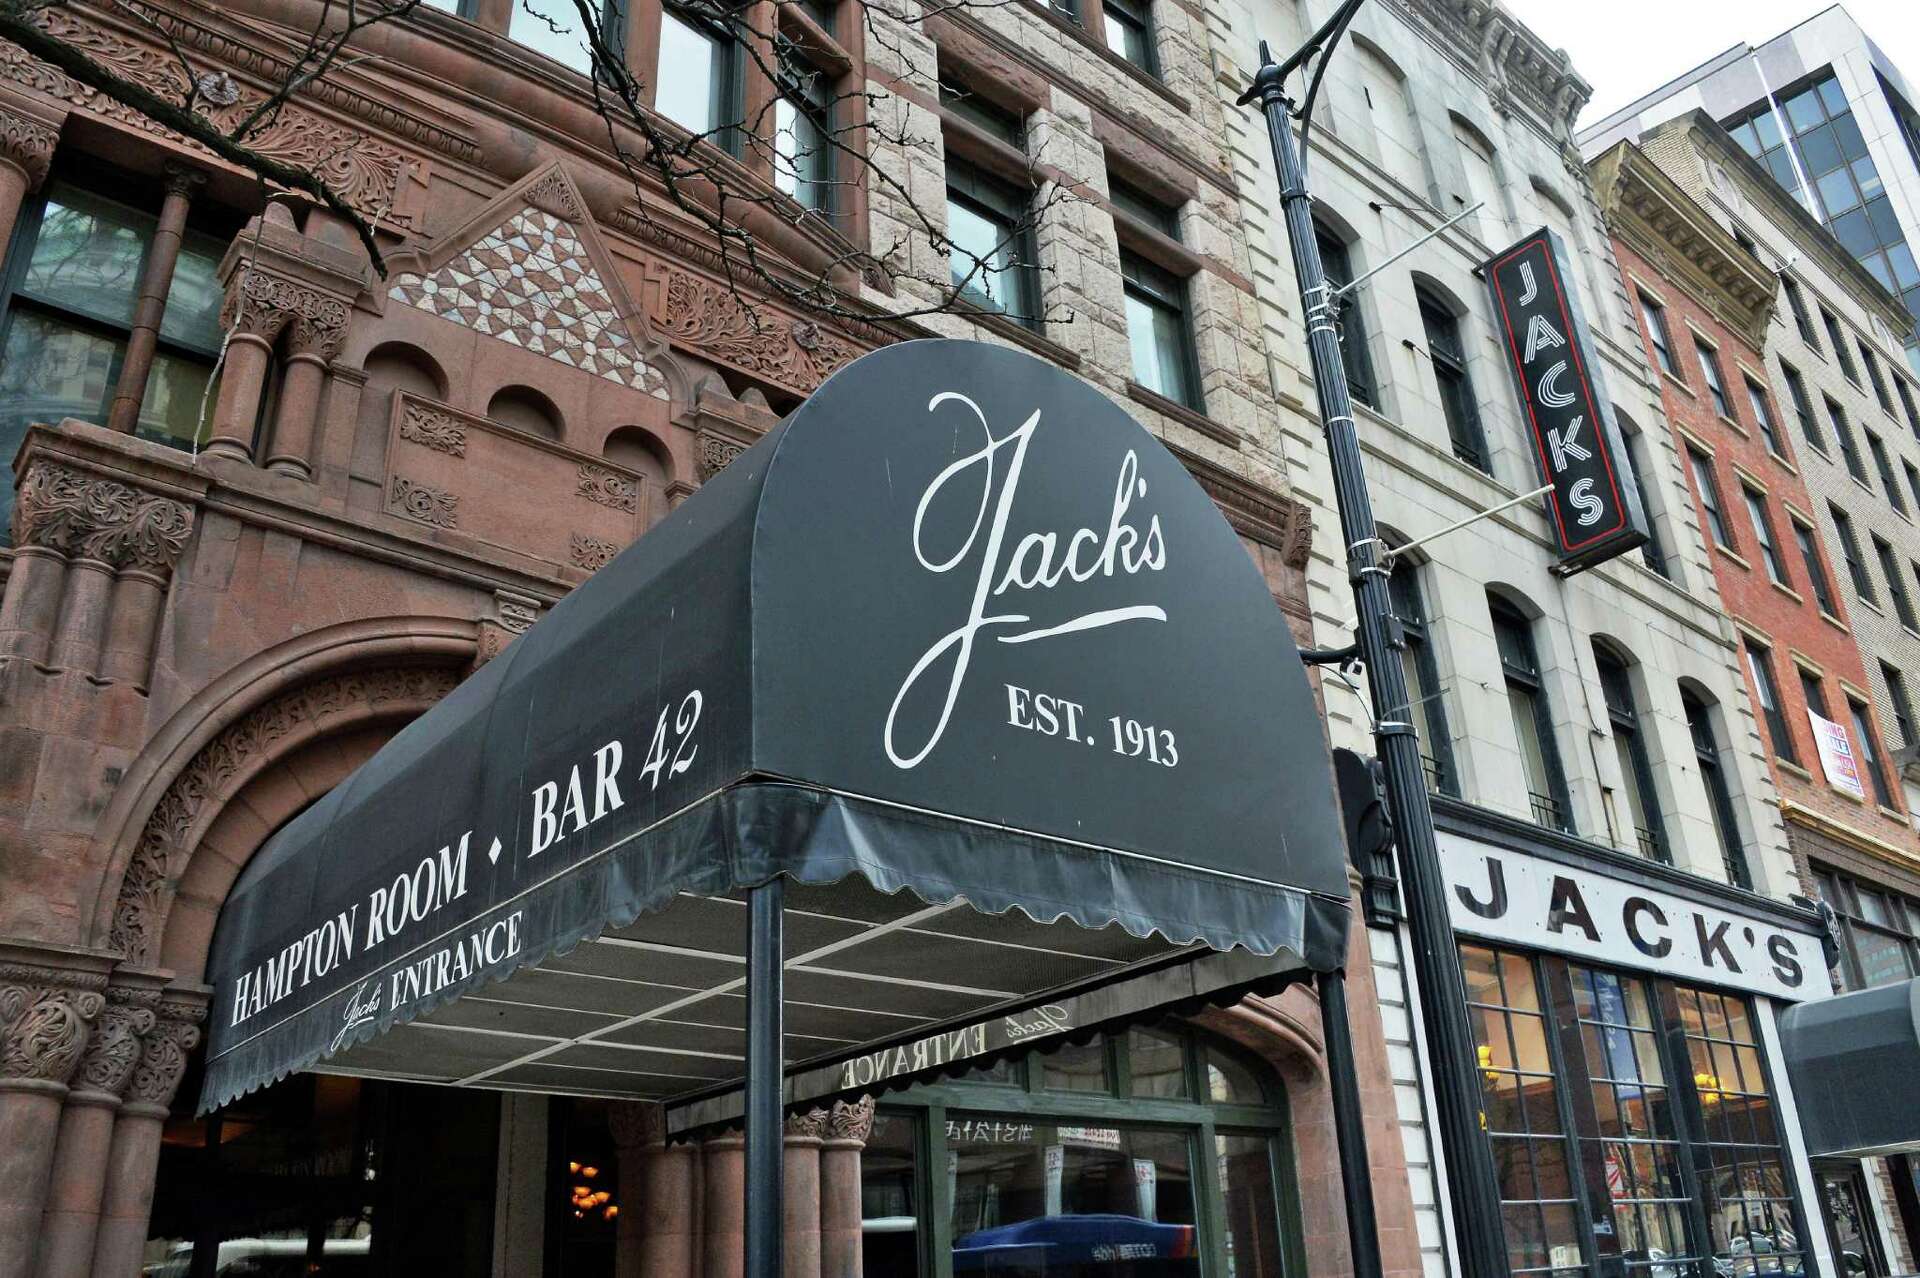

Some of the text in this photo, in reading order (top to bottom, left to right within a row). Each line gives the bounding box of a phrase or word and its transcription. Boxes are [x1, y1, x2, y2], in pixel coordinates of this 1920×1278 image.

[1519, 260, 1604, 526] JACKS
[885, 391, 1166, 769] Jack's
[1004, 683, 1179, 768] EST. 1913
[230, 689, 703, 1027] HAMPTON ROOM BAR 42
[1454, 856, 1804, 988] JACK'S
[330, 910, 522, 1052] Jack's ENTRANCE
